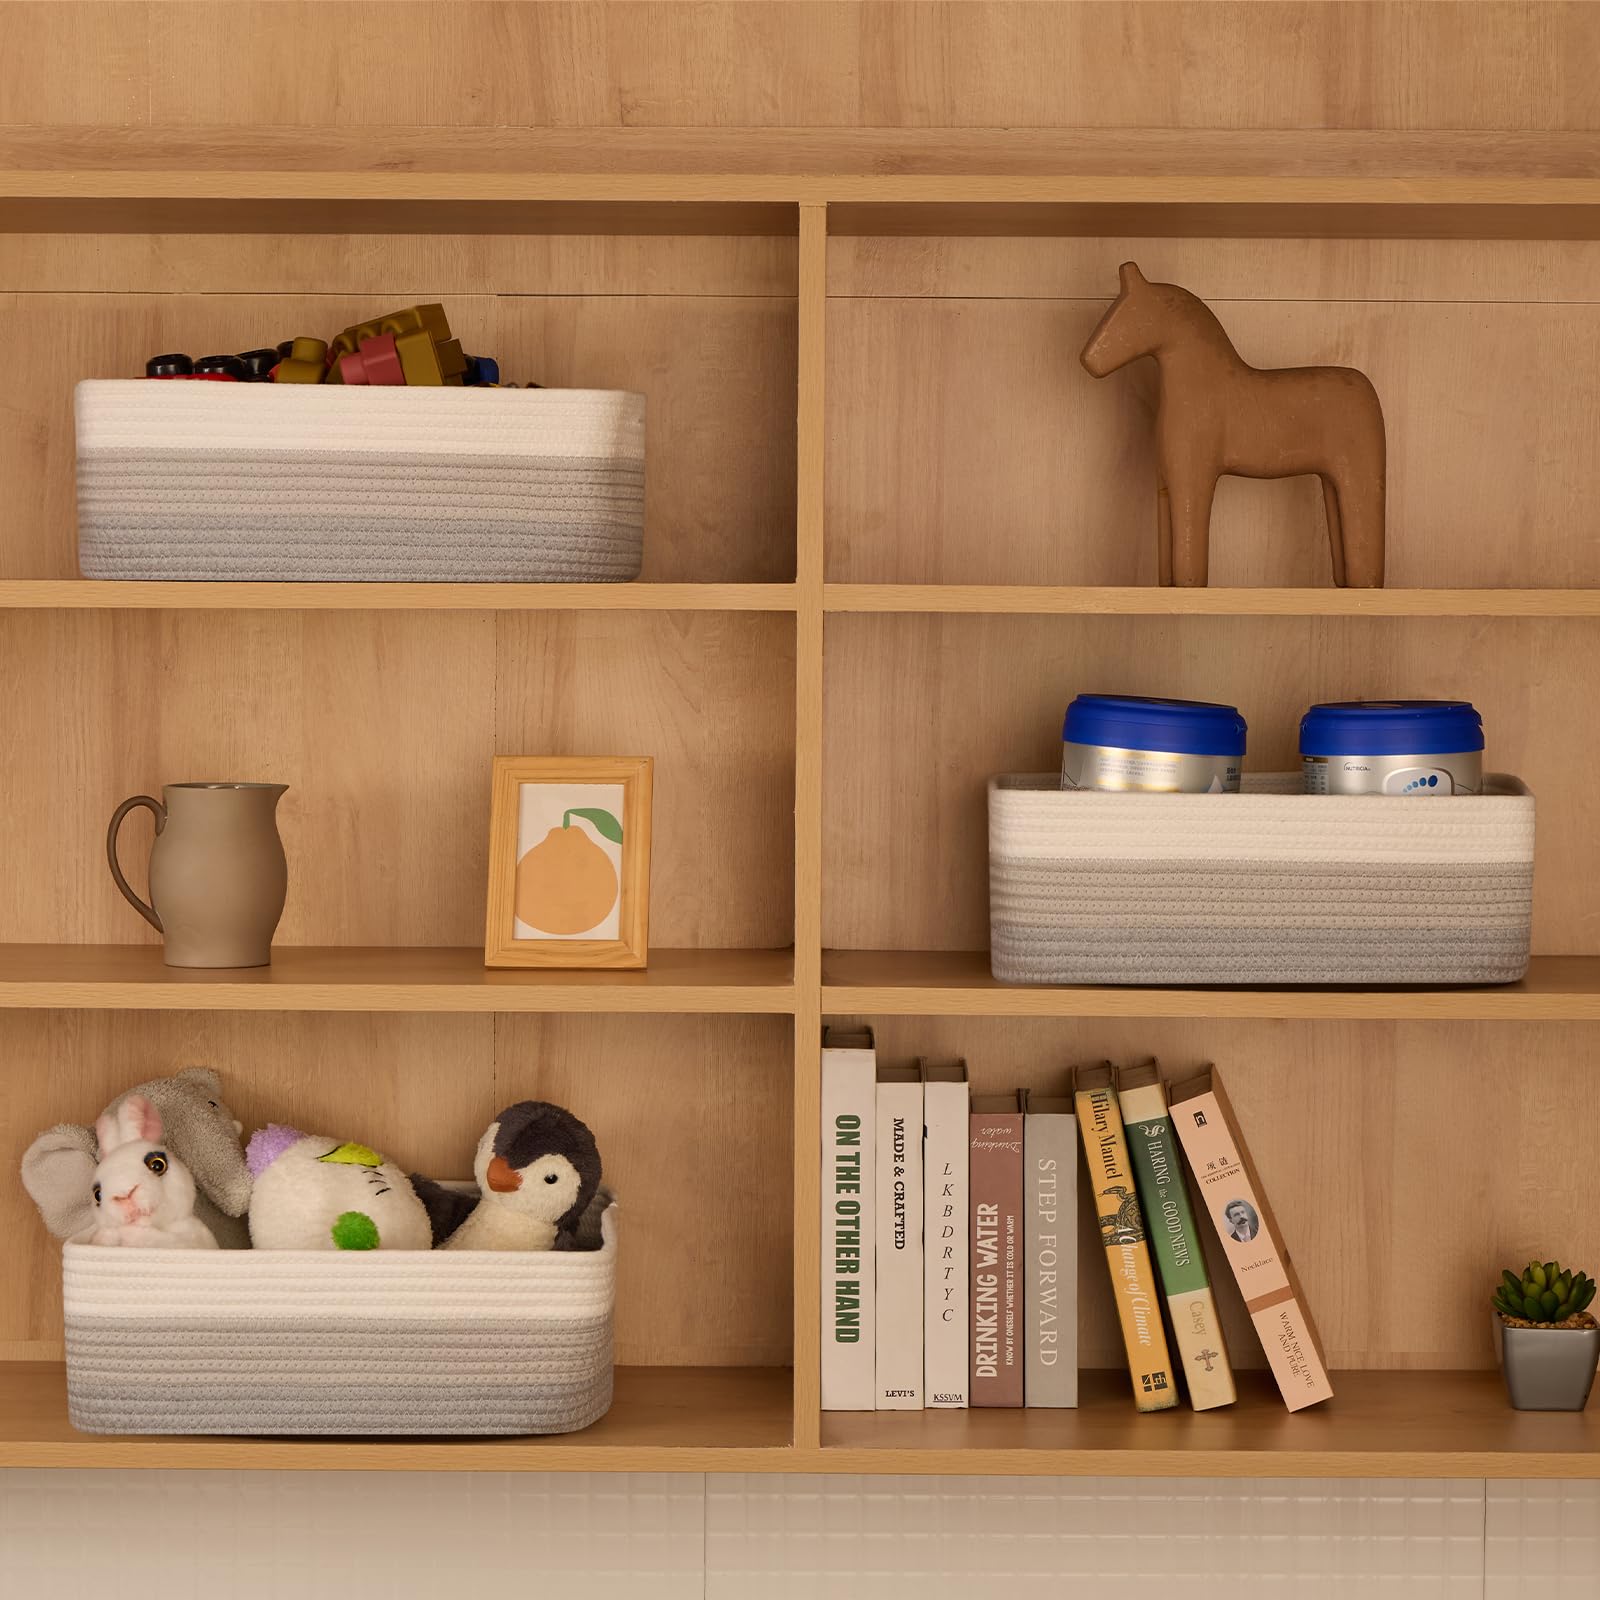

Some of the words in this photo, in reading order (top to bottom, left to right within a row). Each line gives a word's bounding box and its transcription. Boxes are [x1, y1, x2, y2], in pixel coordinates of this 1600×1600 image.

[1090, 1092, 1110, 1133] Hilary
[835, 1114, 861, 1146] ON
[893, 1117, 905, 1163] MADE
[970, 1138, 1022, 1153] Drinking
[981, 1126, 1013, 1138] water
[835, 1151, 861, 1194] THE
[893, 1166, 905, 1177] &
[1099, 1133, 1123, 1180] Mantel
[1039, 1159, 1057, 1223] STEP
[1205, 1167, 1240, 1185] COLLECTION
[1158, 1188, 1168, 1199] the
[893, 1181, 906, 1250] CRAFTED
[1006, 1215, 1014, 1234] WARM
[1117, 1223, 1135, 1233] A
[1162, 1201, 1183, 1234] GOOD
[835, 1200, 861, 1274] OTHER
[976, 1203, 998, 1269] WATER
[1006, 1235, 1014, 1244] OR
[1169, 1231, 1190, 1267] NEWS
[1006, 1245, 1014, 1260] COLD
[1119, 1235, 1139, 1282] Change
[1240, 1257, 1273, 1273] Necklace
[1006, 1270, 1014, 1278] IT
[1124, 1283, 1147, 1297] of
[1006, 1279, 1014, 1308] WHETHER
[1039, 1234, 1058, 1366] FORWARD
[835, 1280, 860, 1343] HAND
[976, 1274, 998, 1377] DRINKING
[1006, 1309, 1014, 1336] ONESELF
[1131, 1297, 1152, 1347] Climate
[1189, 1300, 1207, 1336] Casey
[1006, 1337, 1014, 1345] BY
[1006, 1346, 1014, 1366] KNOW
[1278, 1333, 1291, 1353] AND
[1286, 1354, 1301, 1377] PURE
[1279, 1312, 1296, 1341] WARM
[1291, 1341, 1305, 1363] NICE
[1299, 1361, 1315, 1388] LOVE
[885, 1390, 915, 1398] LEVI'S
[933, 1393, 964, 1402] KSSVM
